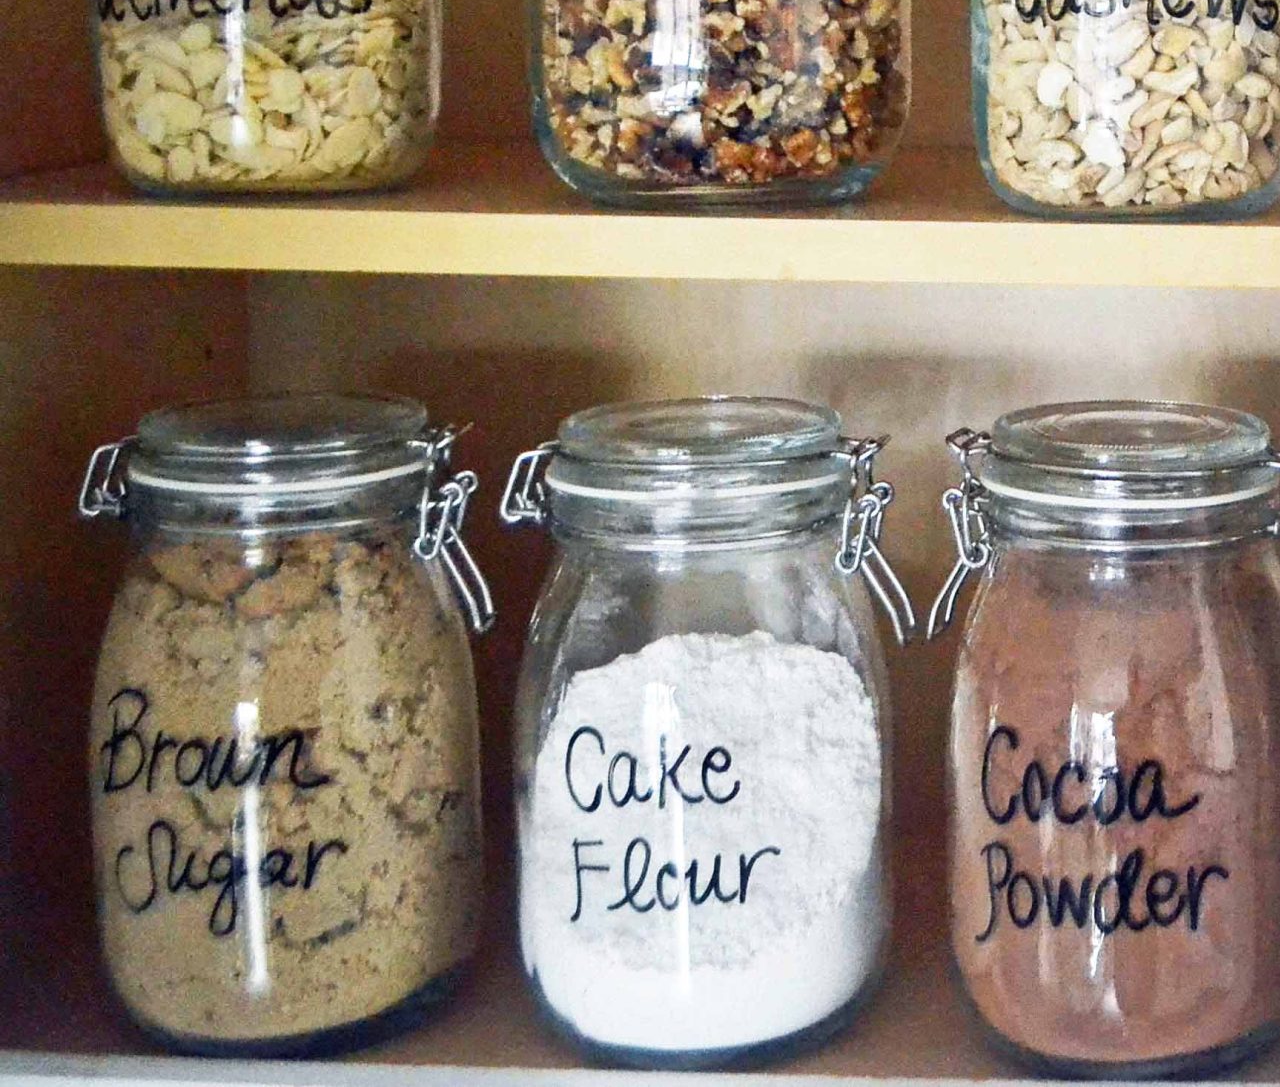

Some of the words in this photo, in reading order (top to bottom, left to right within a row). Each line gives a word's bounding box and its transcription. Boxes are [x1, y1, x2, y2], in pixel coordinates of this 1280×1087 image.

[100, 687, 334, 793] Brown
[565, 725, 741, 813] Cake
[980, 725, 1201, 826] Cocoa
[115, 819, 350, 937] Sugar
[569, 836, 782, 923] Flour
[975, 840, 1230, 944] Powder
